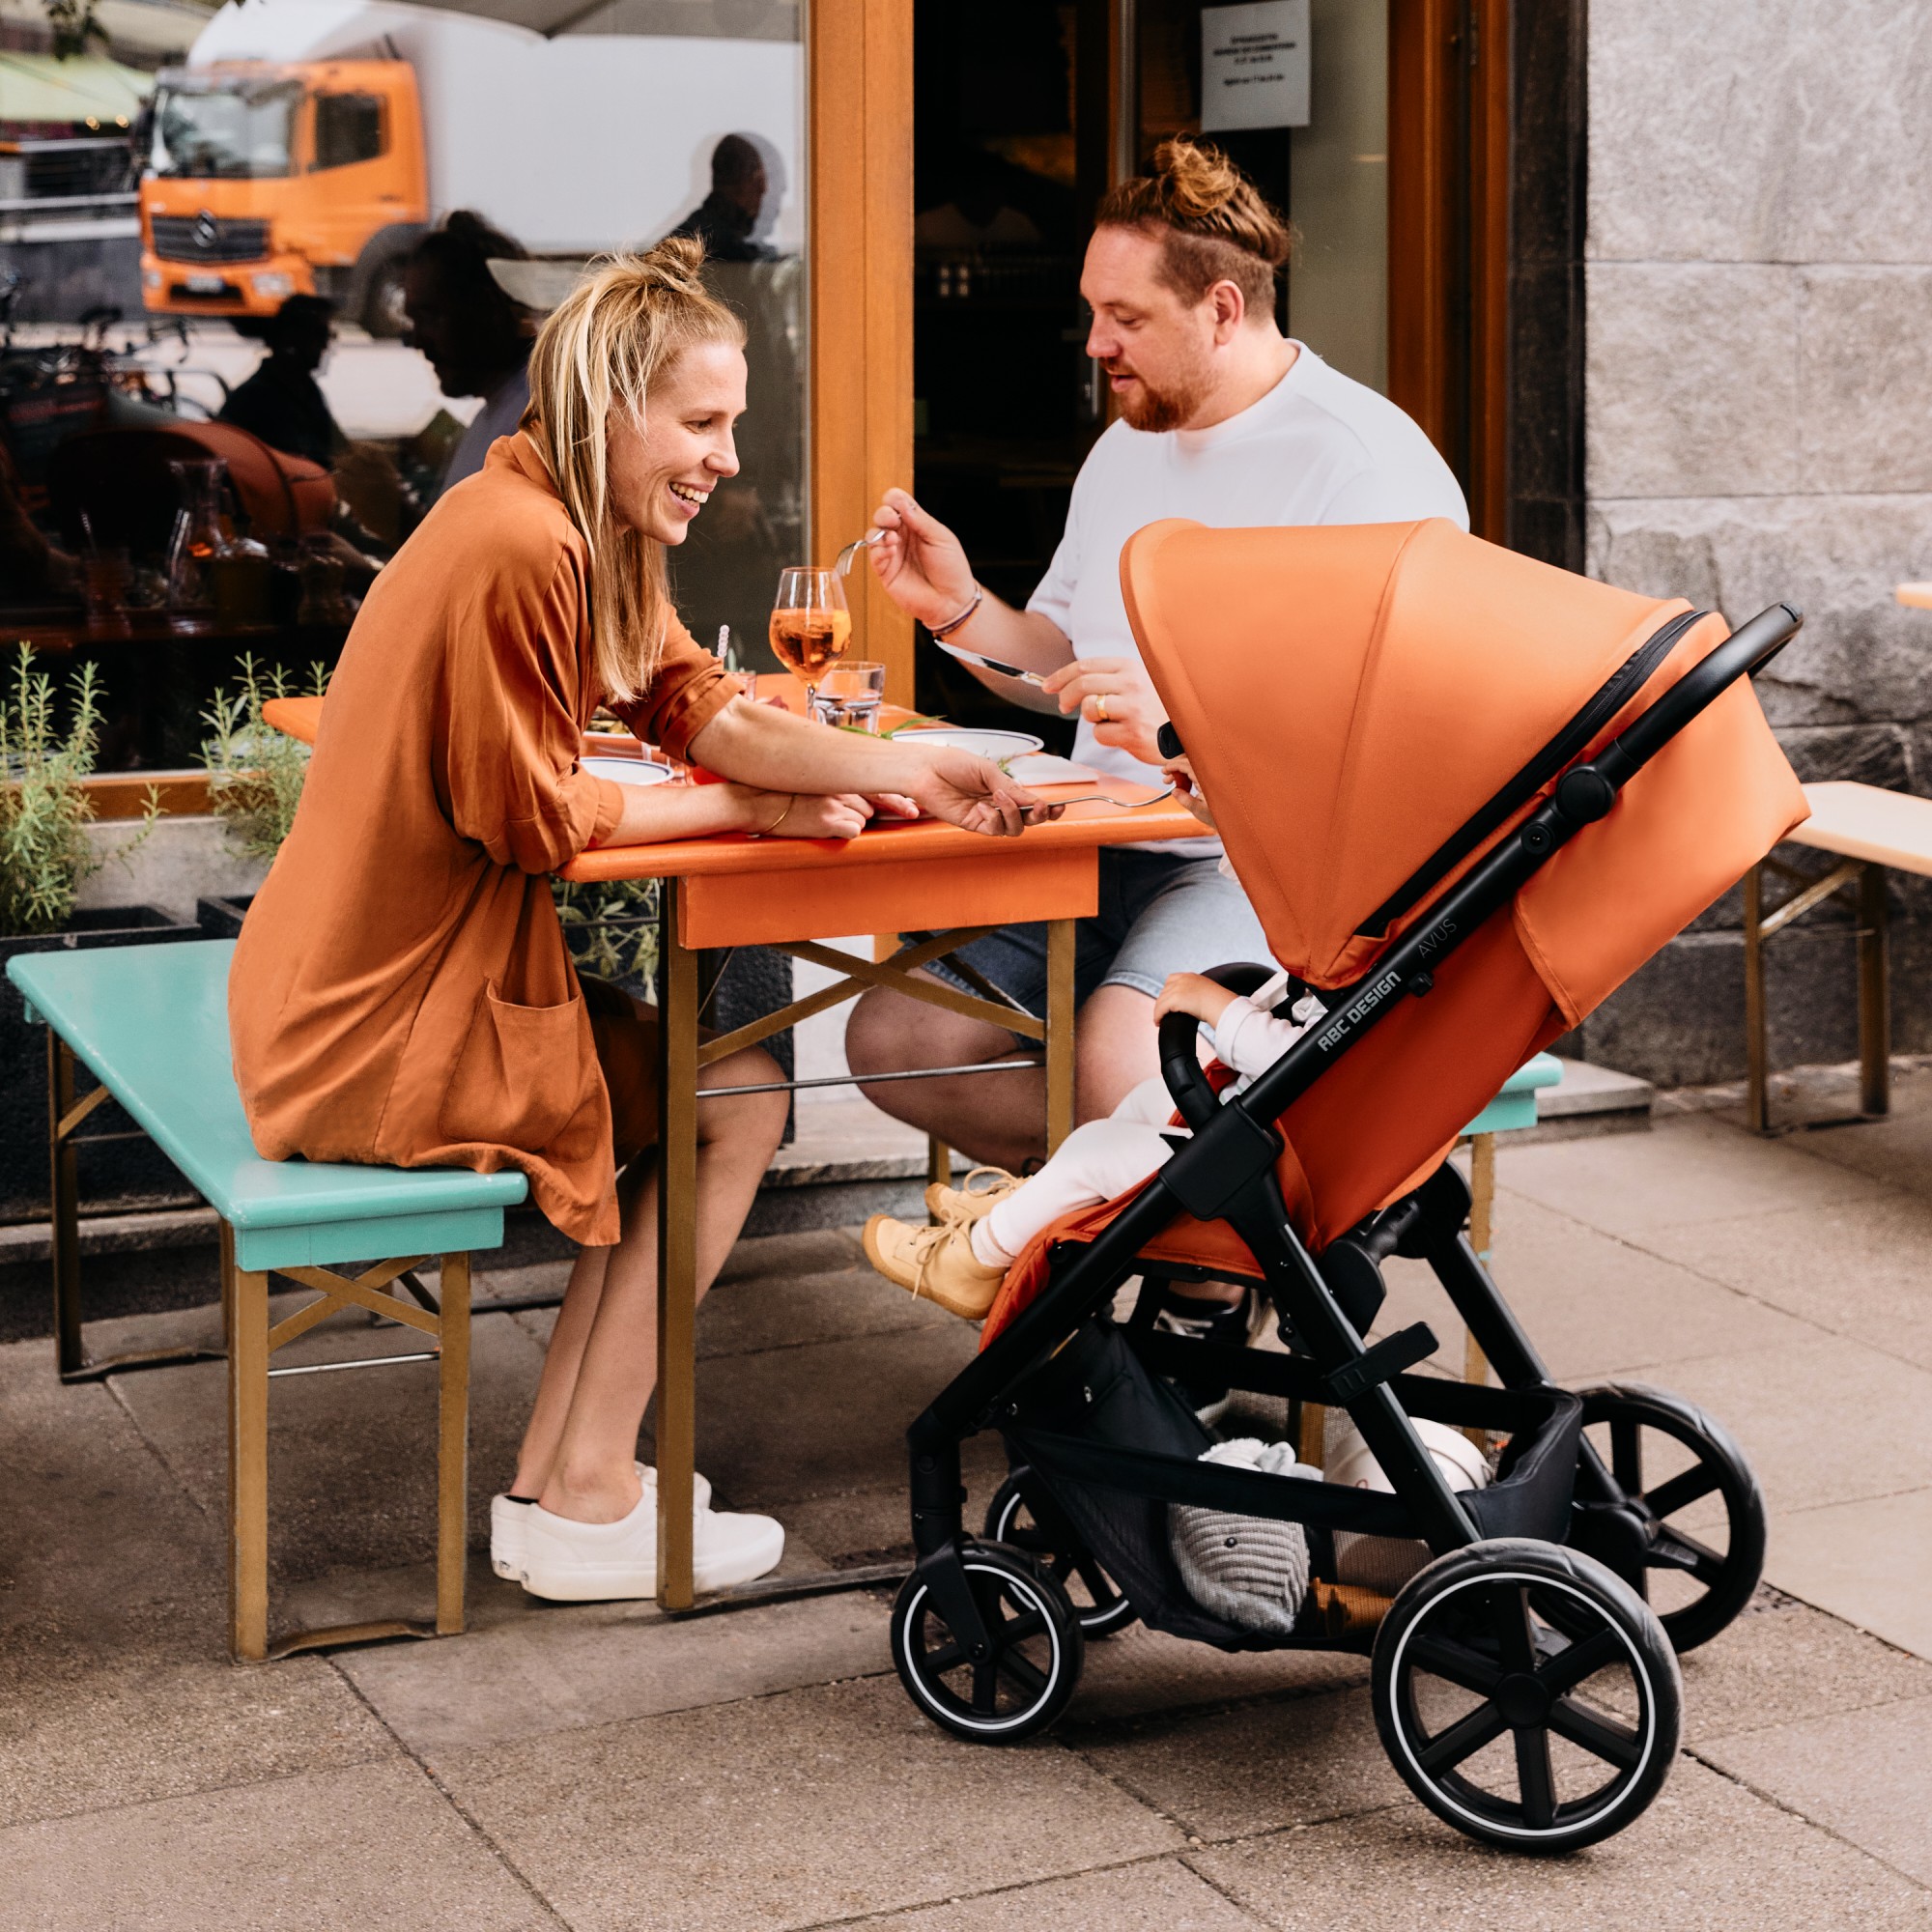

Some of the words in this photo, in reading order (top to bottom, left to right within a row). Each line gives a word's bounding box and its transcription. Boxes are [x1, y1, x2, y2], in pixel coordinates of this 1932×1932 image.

[1418, 919, 1457, 958] AVUS
[1318, 1019, 1350, 1051] ABC
[1347, 971, 1402, 1024] DESIGN
